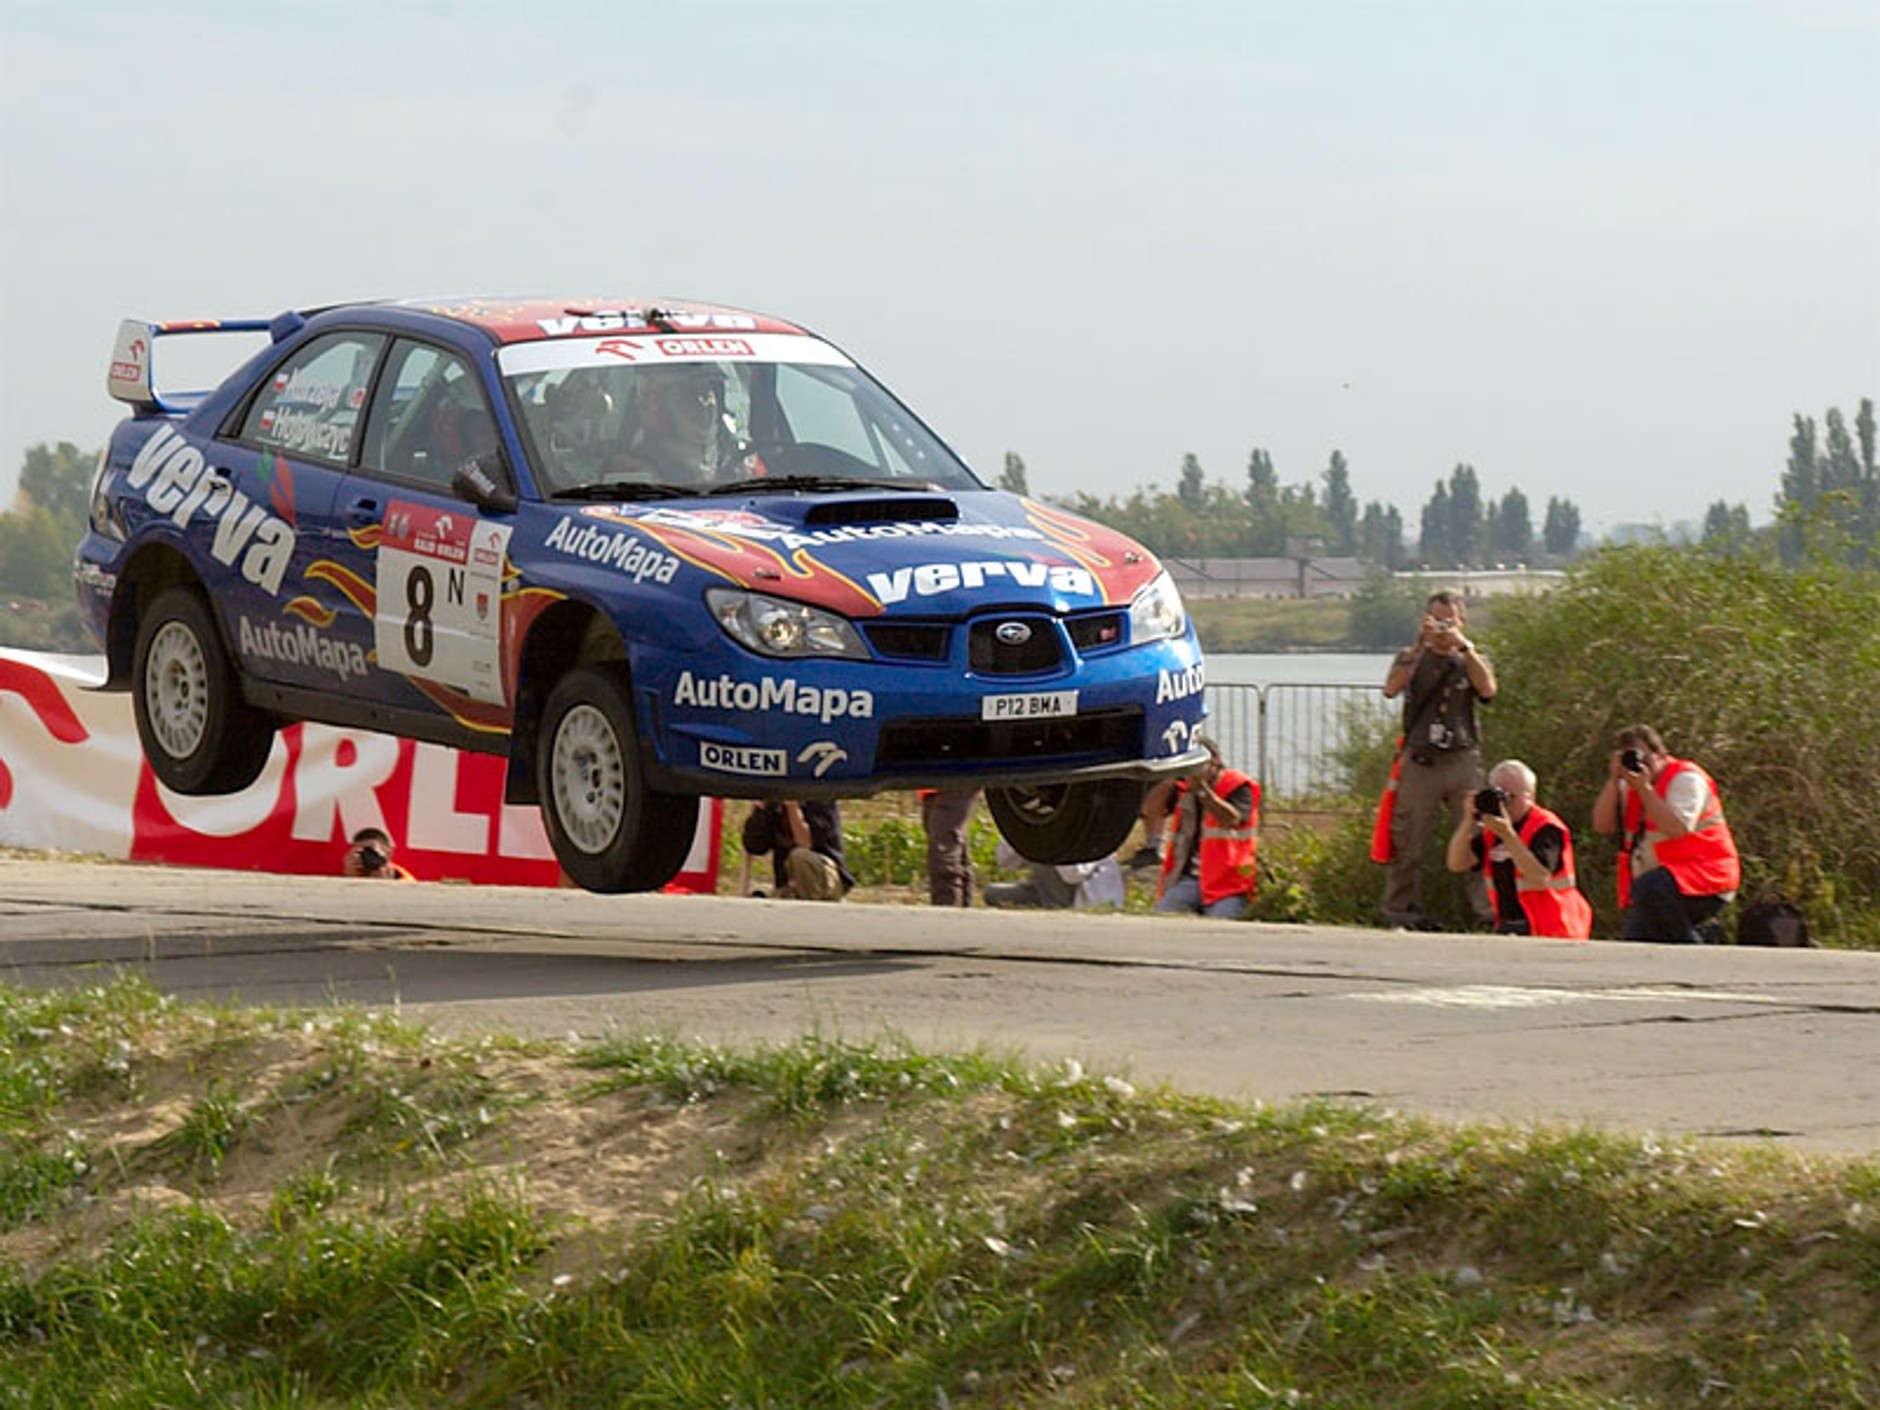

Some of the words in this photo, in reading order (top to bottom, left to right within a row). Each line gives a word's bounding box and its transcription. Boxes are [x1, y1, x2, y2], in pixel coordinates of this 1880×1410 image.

[663, 340, 749, 354] ORLEN
[127, 424, 296, 597] verva
[545, 516, 680, 584] AutoMapa
[867, 562, 1095, 604] verva
[404, 565, 434, 669] 8
[448, 567, 464, 607] N
[239, 615, 368, 681] AutoMapa
[674, 671, 874, 723] AutoMapa
[996, 698, 1025, 716] P12
[705, 747, 780, 771] ORLEN
